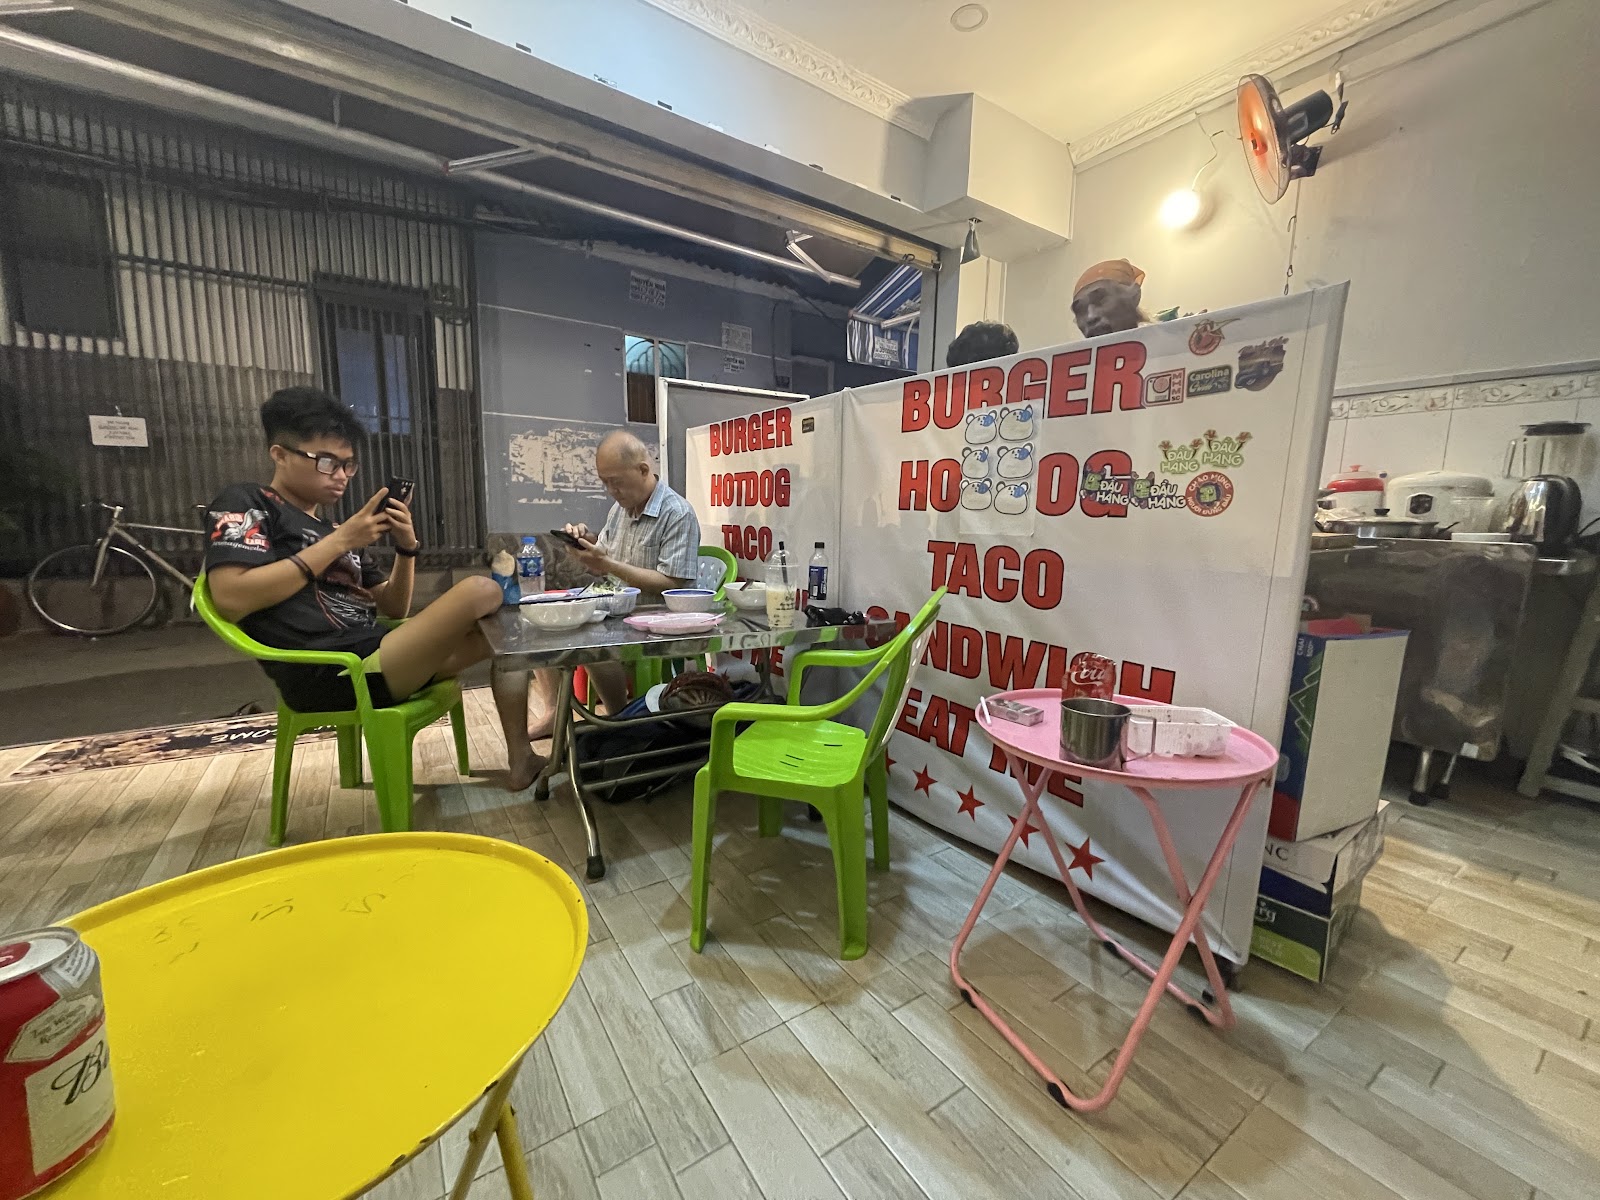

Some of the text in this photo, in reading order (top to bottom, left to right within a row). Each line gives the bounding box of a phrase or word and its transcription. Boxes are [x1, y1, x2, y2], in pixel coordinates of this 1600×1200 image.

[901, 340, 1147, 433] BURGER
[1189, 368, 1230, 381] Carolina
[709, 406, 793, 457] BURGER
[710, 468, 791, 508] HOTDOG
[898, 450, 1133, 518] HOOG
[721, 524, 773, 563] TACO
[927, 540, 1065, 610] TACO
[895, 687, 977, 758] EAT
